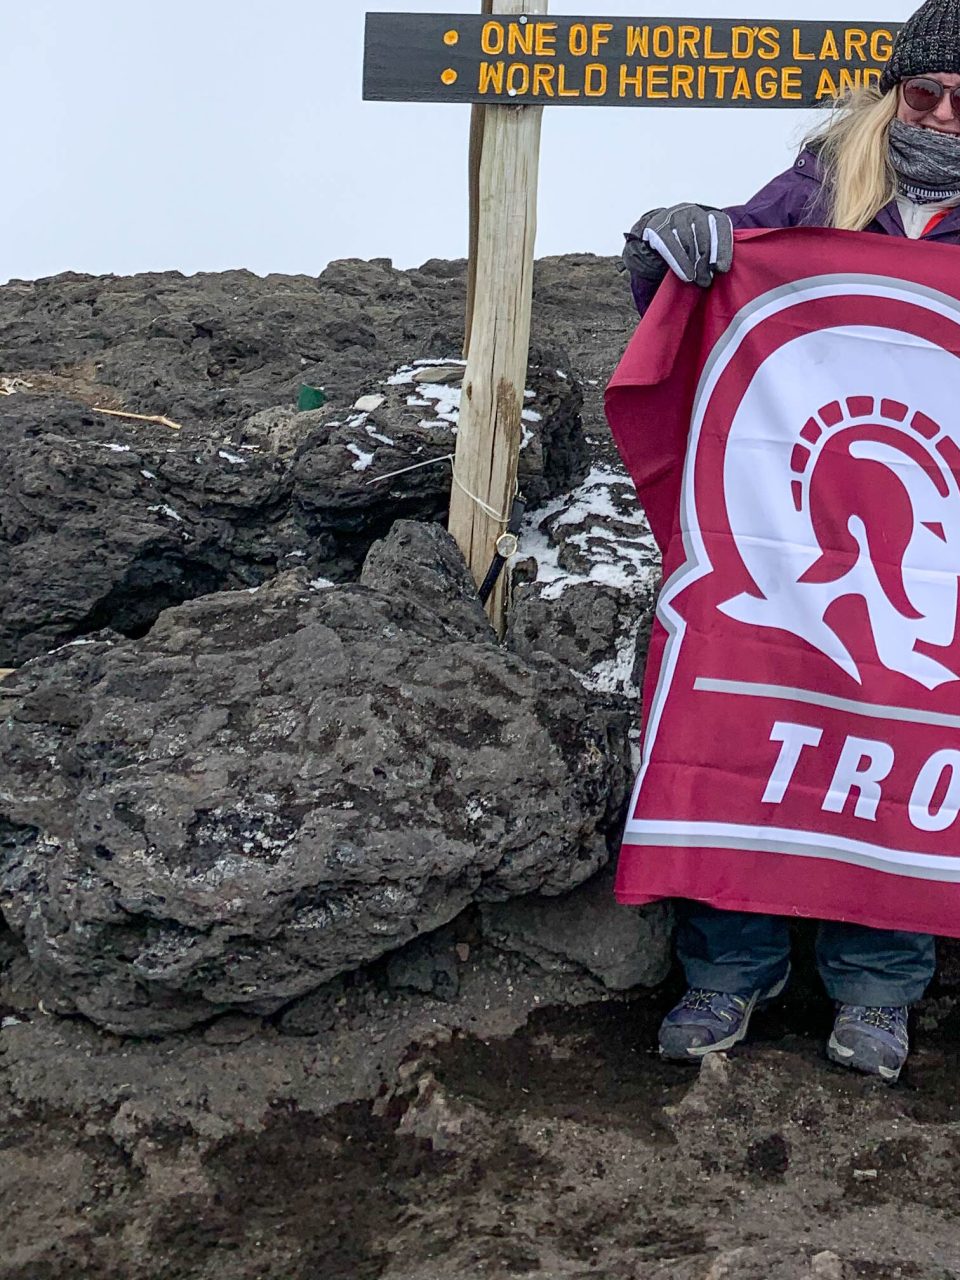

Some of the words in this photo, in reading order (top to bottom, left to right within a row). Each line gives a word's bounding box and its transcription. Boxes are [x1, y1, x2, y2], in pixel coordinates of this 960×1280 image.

[481, 21, 556, 56] ONE
[569, 23, 612, 56] OF
[626, 25, 780, 60] WORLD'S
[793, 29, 893, 61] LARG
[478, 61, 607, 96] WORLD
[619, 64, 802, 99] HERITAGE
